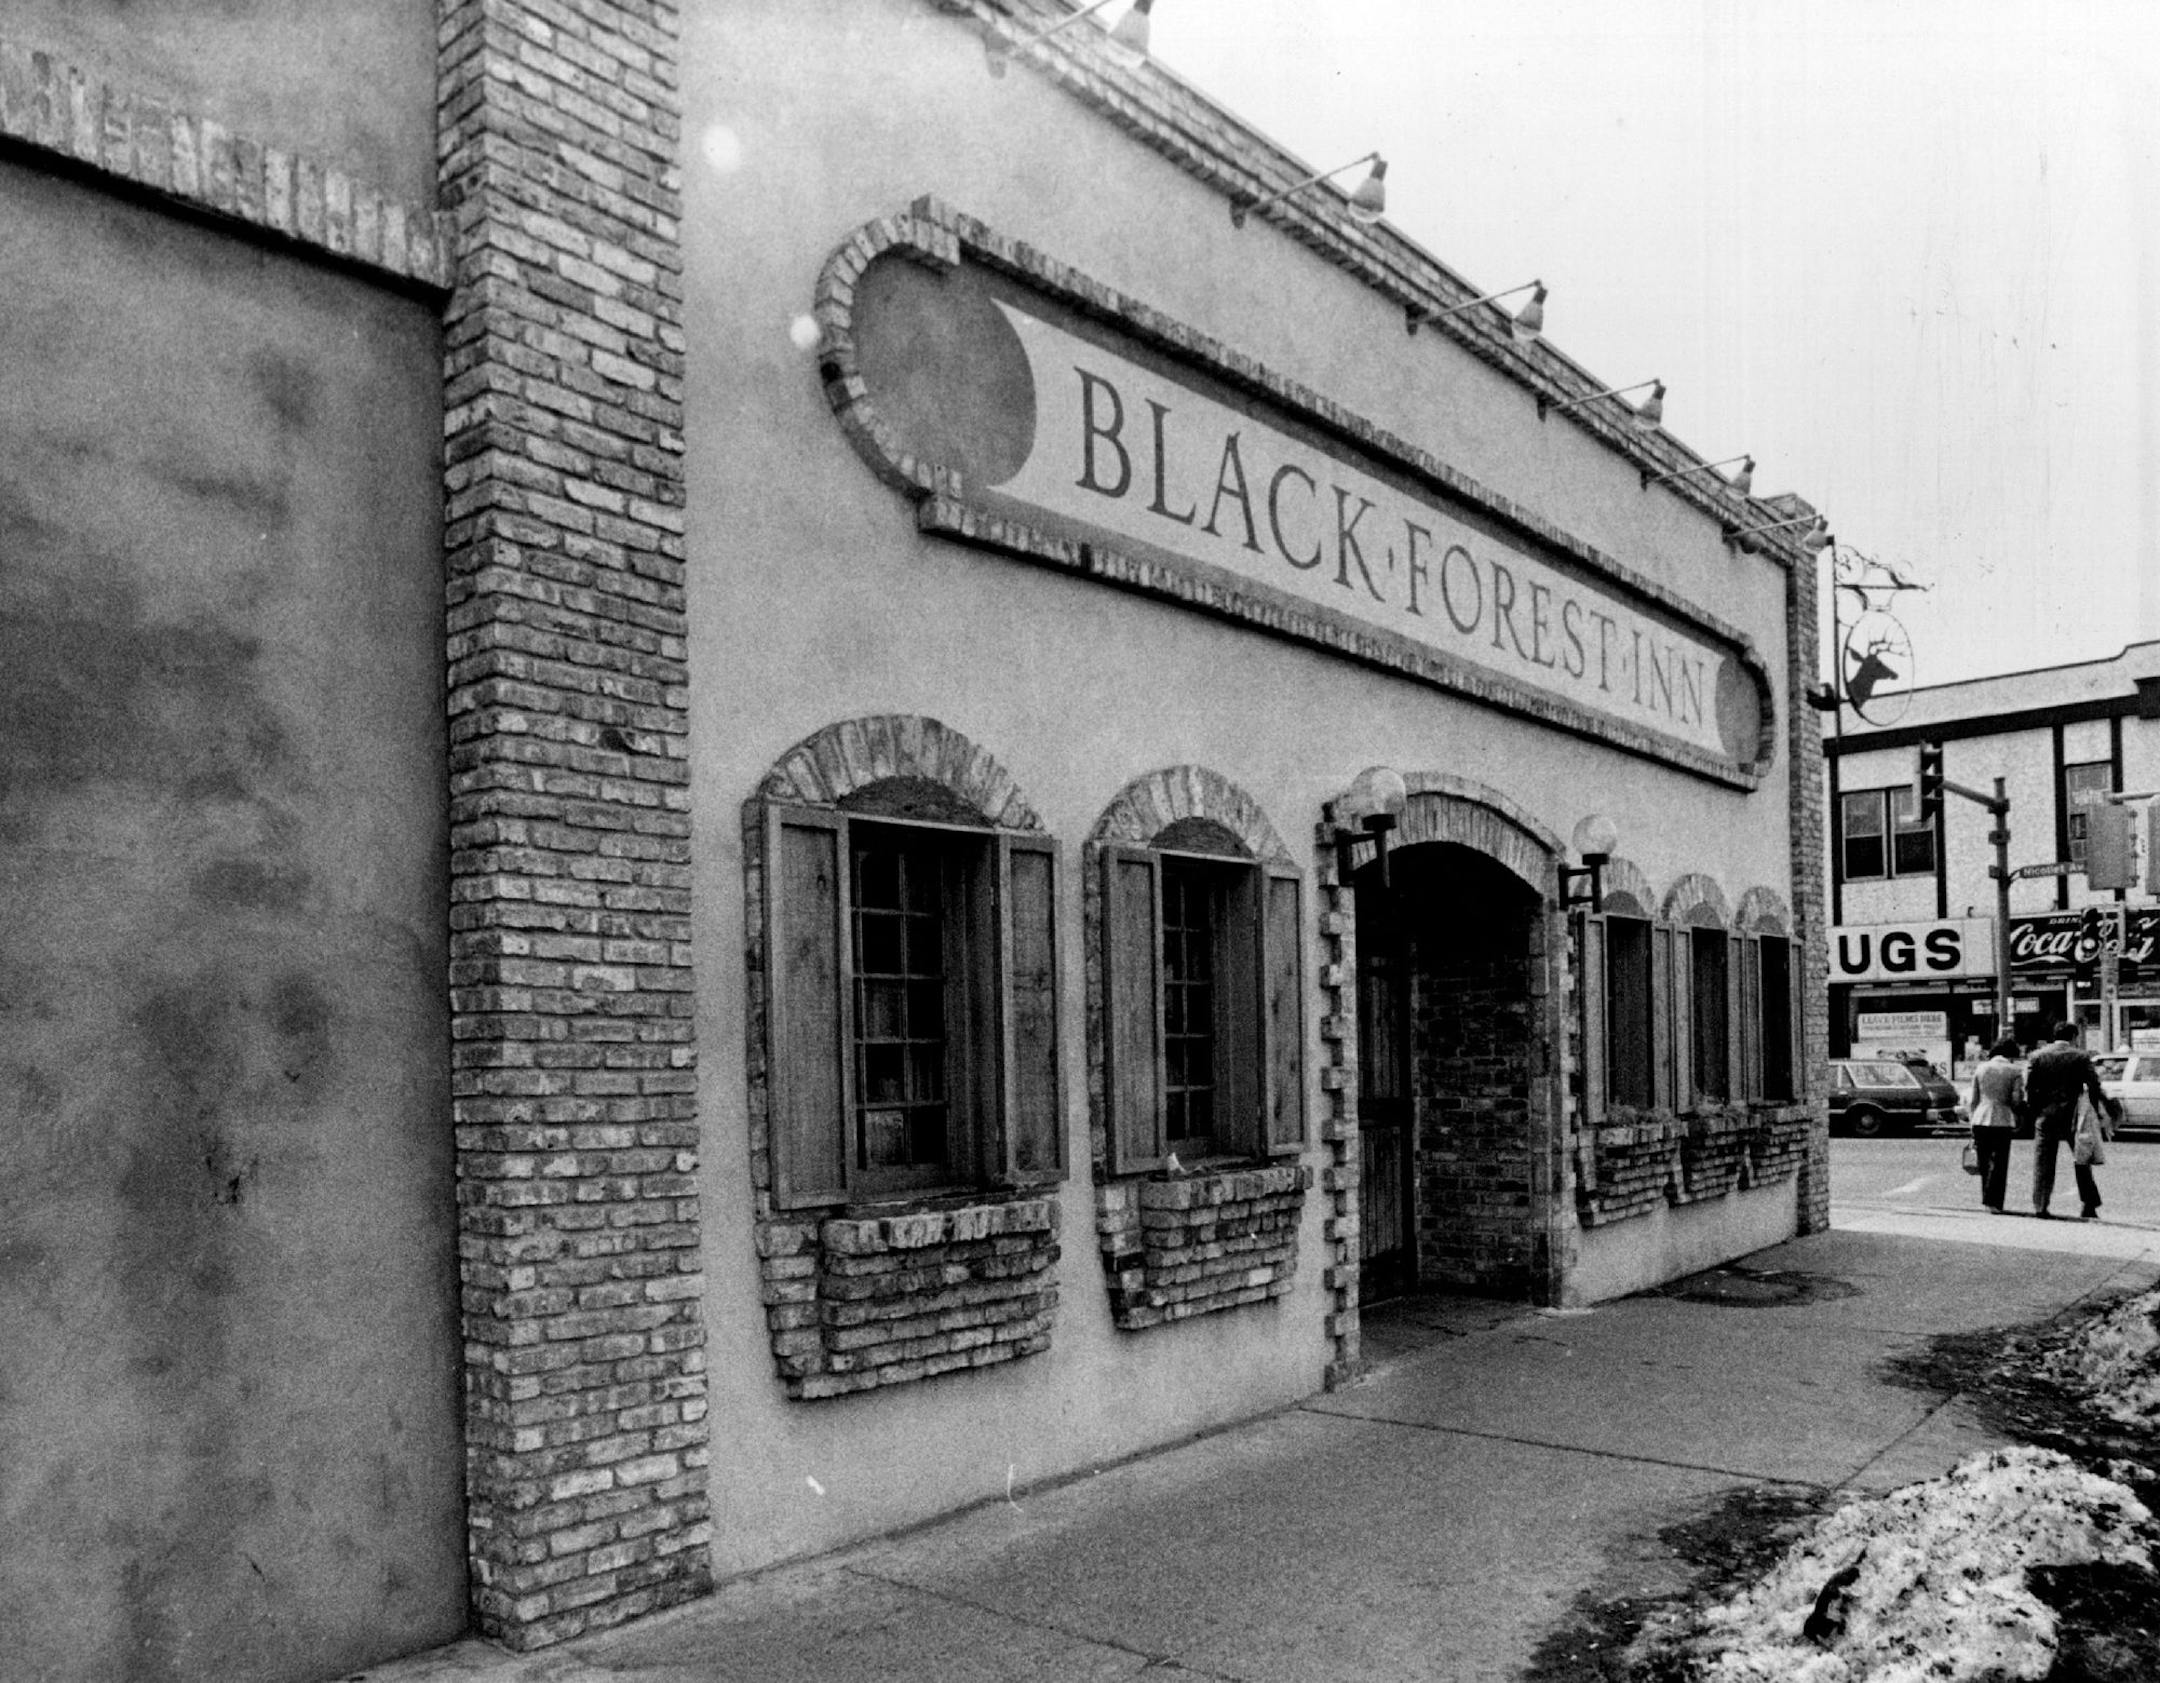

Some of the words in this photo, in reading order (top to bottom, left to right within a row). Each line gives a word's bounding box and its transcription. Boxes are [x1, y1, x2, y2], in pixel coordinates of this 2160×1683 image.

[1073, 366, 1385, 602] BLACK
[1404, 517, 1617, 692] FOREST
[1631, 629, 1706, 729] INN
[2048, 916, 2081, 925] DRIN
[1838, 928, 1961, 975] UGS
